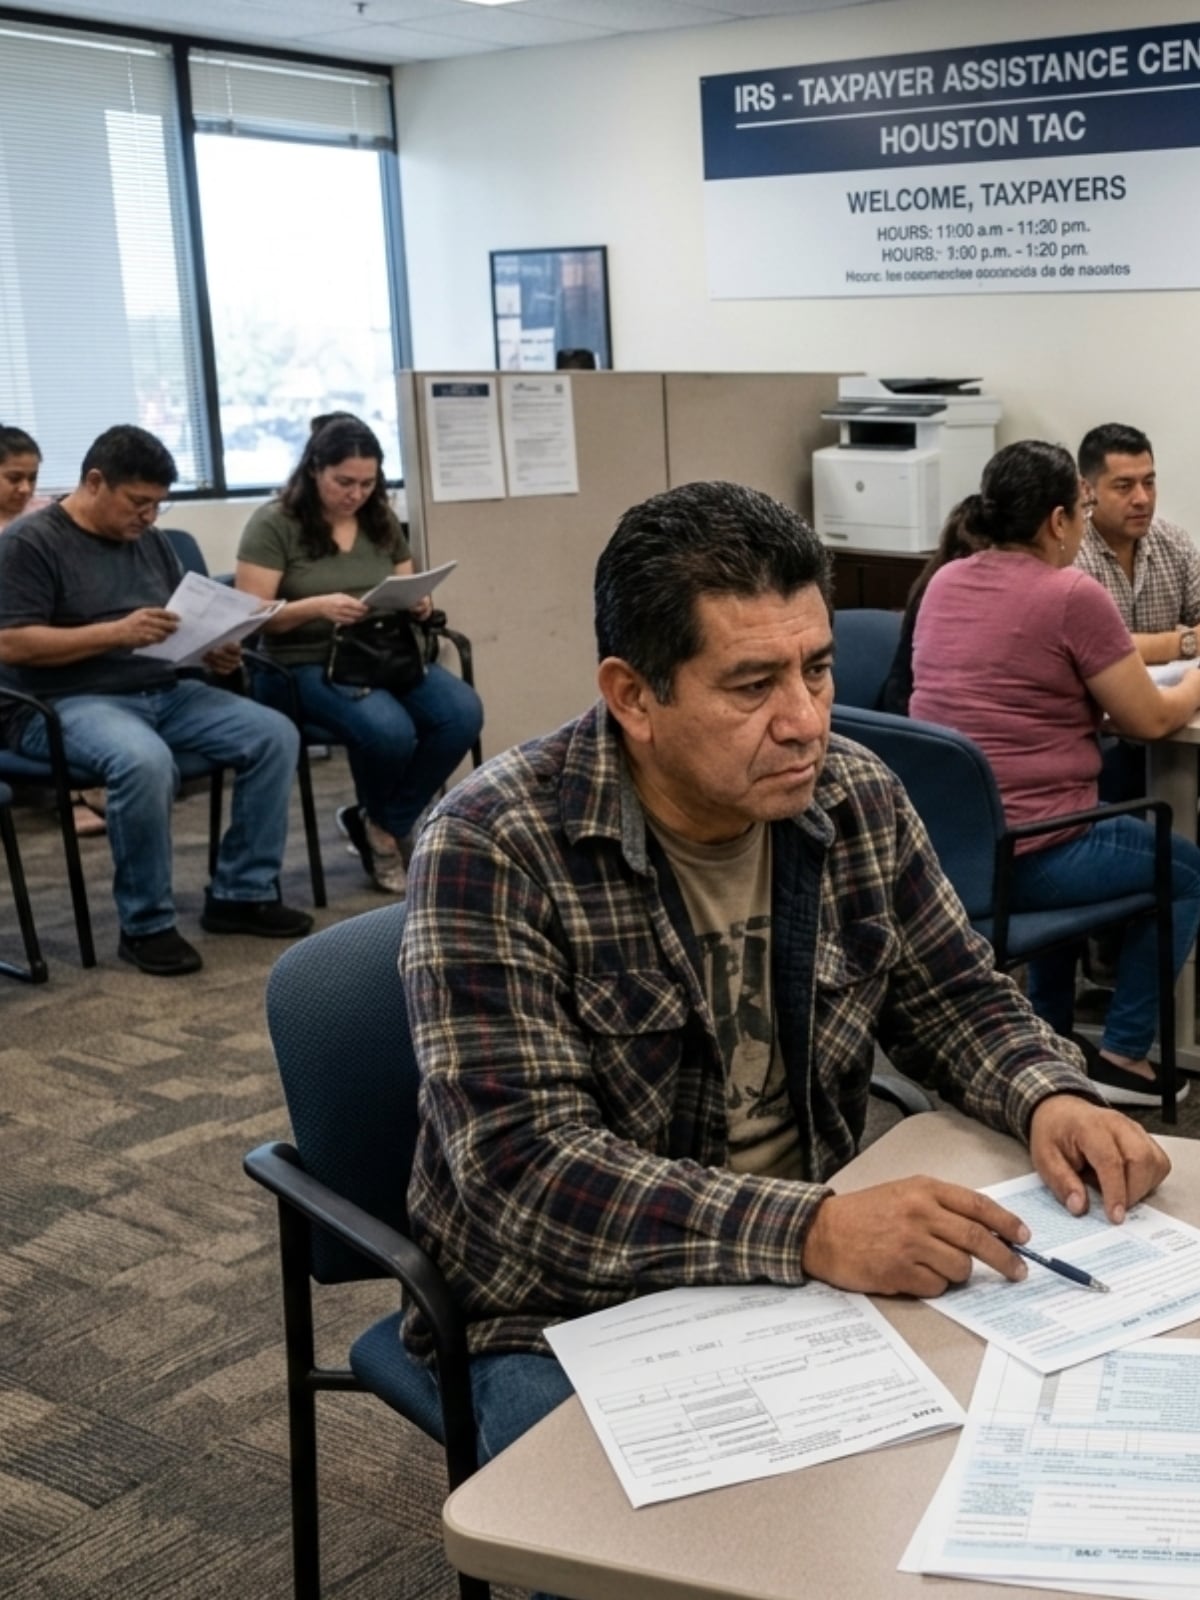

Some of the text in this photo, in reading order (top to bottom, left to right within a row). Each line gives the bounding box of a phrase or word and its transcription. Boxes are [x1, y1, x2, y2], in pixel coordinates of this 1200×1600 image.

[735, 82, 776, 113] IRS
[798, 66, 934, 107] TAXPAYER
[942, 45, 1128, 94] ASSISTANCE
[880, 110, 1087, 155] HOUSTON TAC
[847, 175, 1127, 214] WELCOME, TAXPAYERS
[877, 224, 933, 241] HOURS:
[1026, 241, 1057, 257] 1:20
